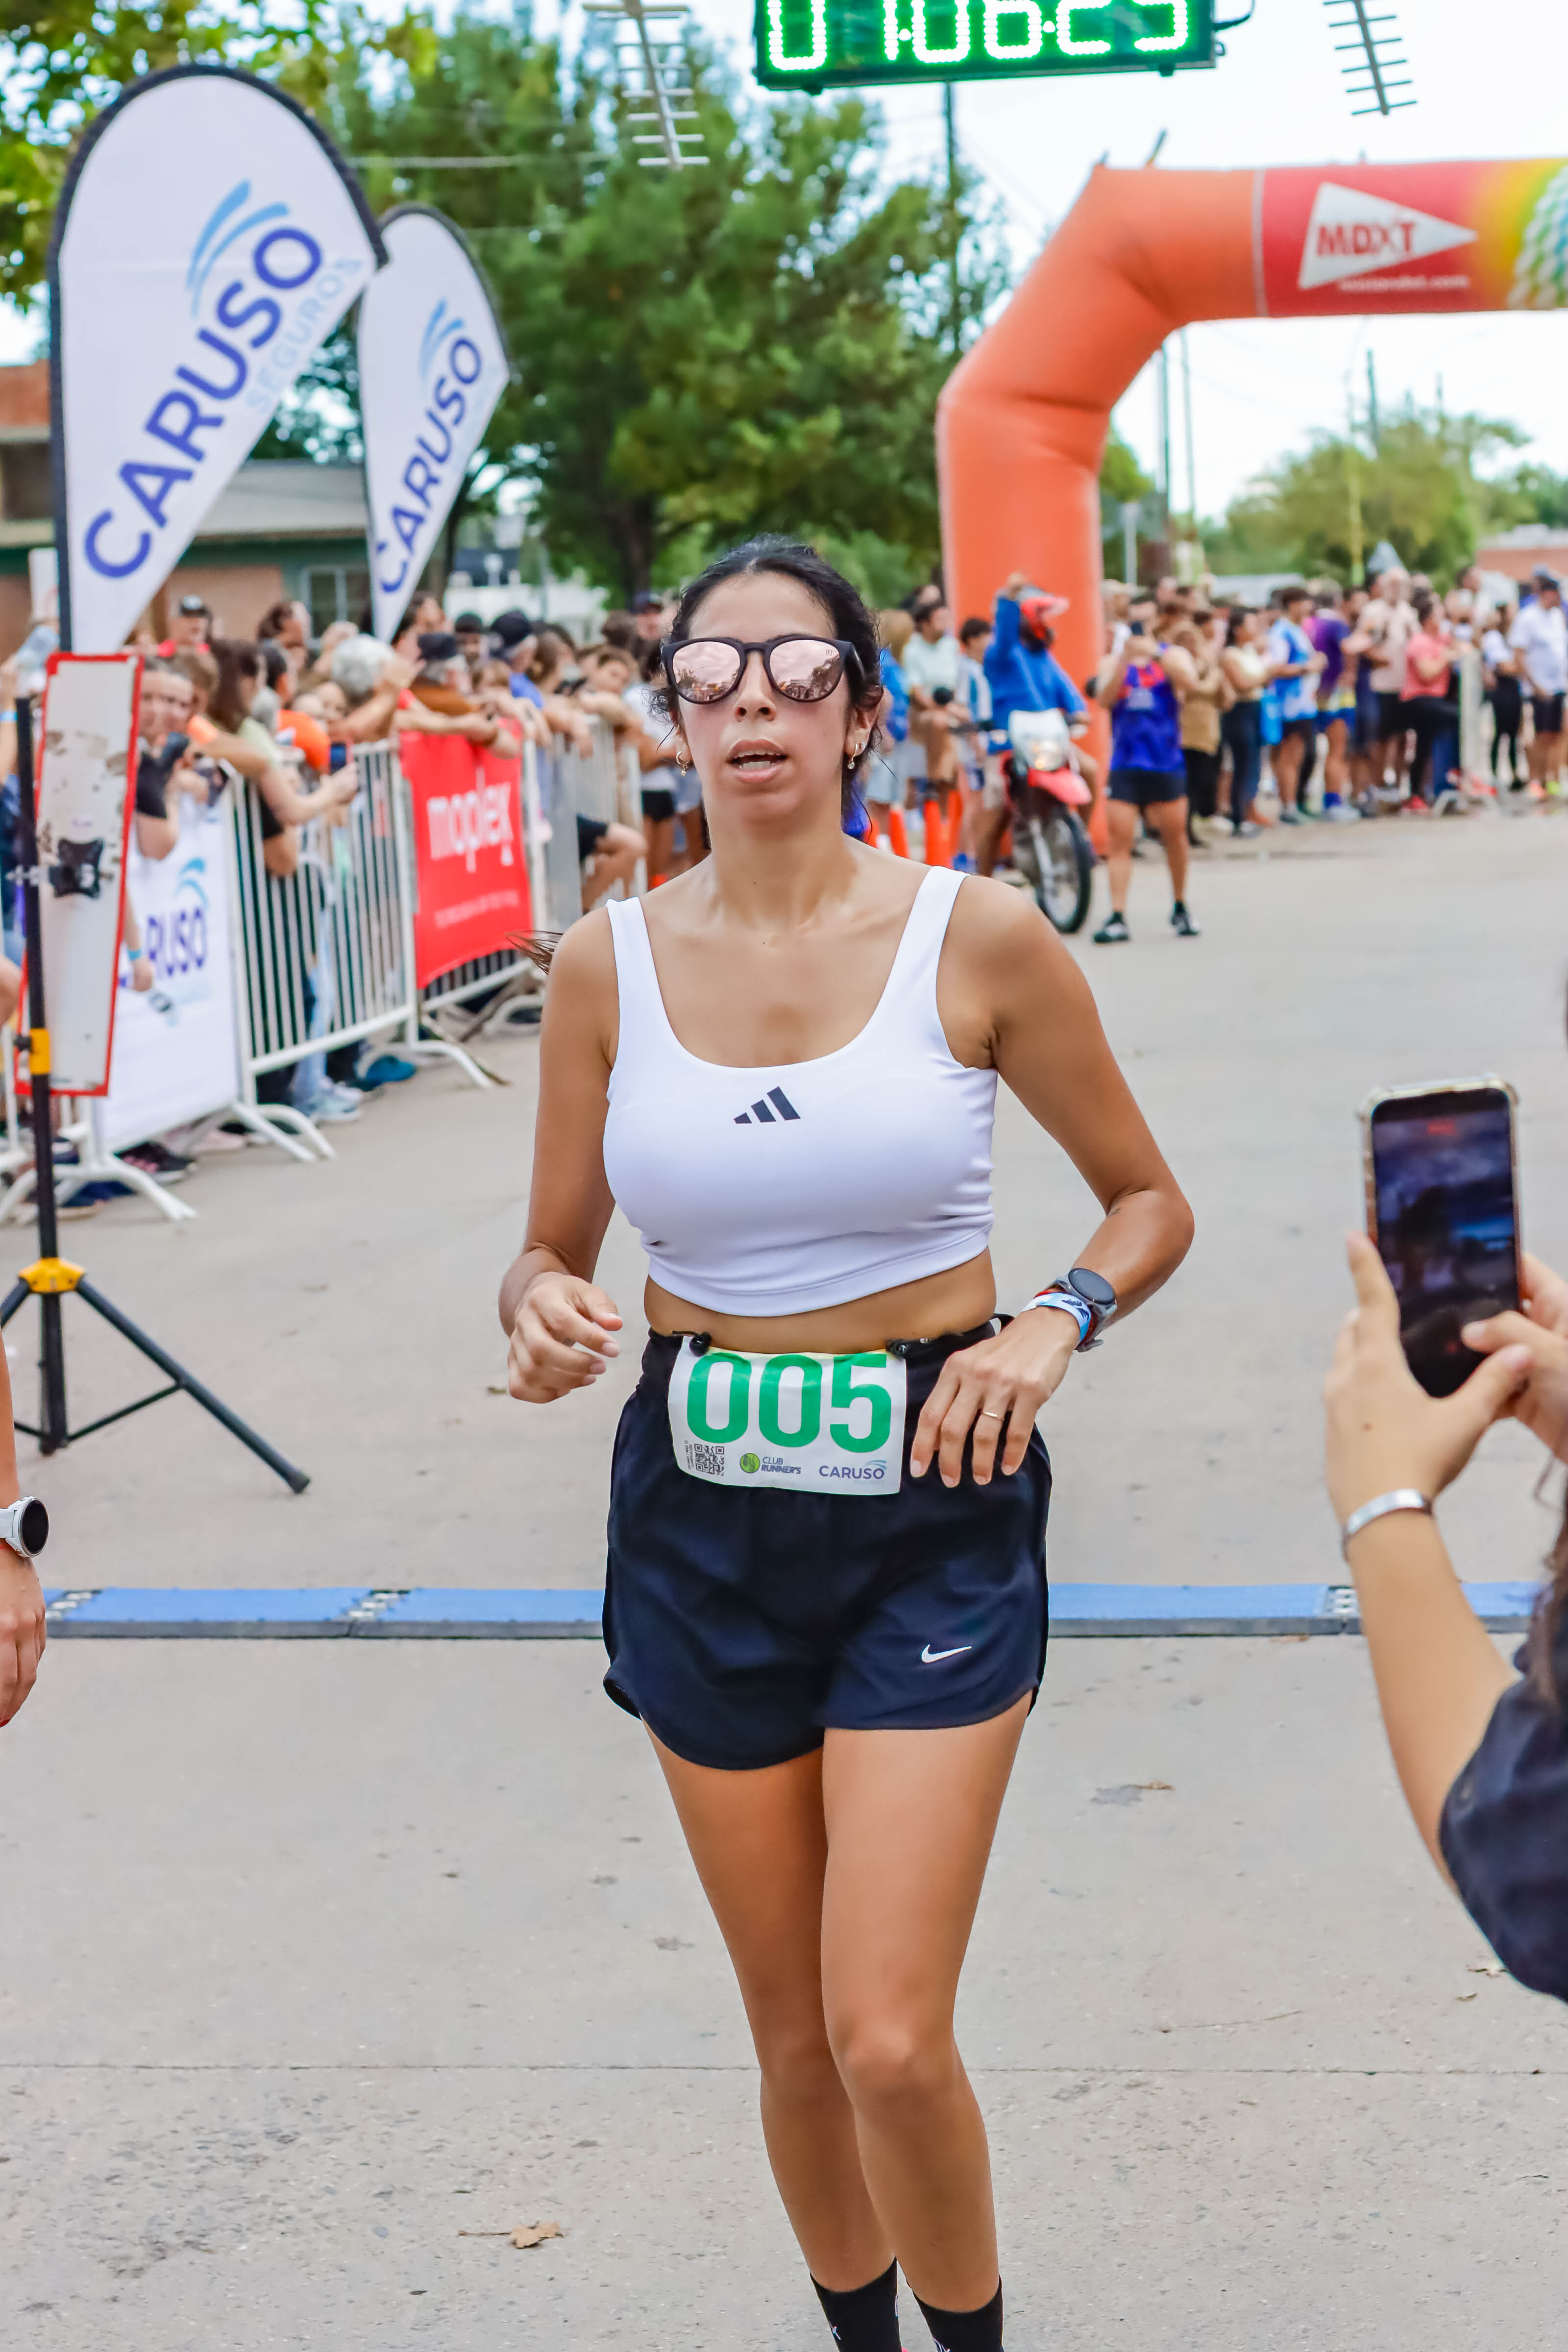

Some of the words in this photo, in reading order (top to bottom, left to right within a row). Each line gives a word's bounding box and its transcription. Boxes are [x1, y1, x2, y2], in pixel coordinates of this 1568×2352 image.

[84, 226, 321, 579] CARUSO
[687, 1352, 891, 1453] 005
[762, 1456, 784, 1465] CLUB
[819, 1465, 885, 1479] CARUSO
